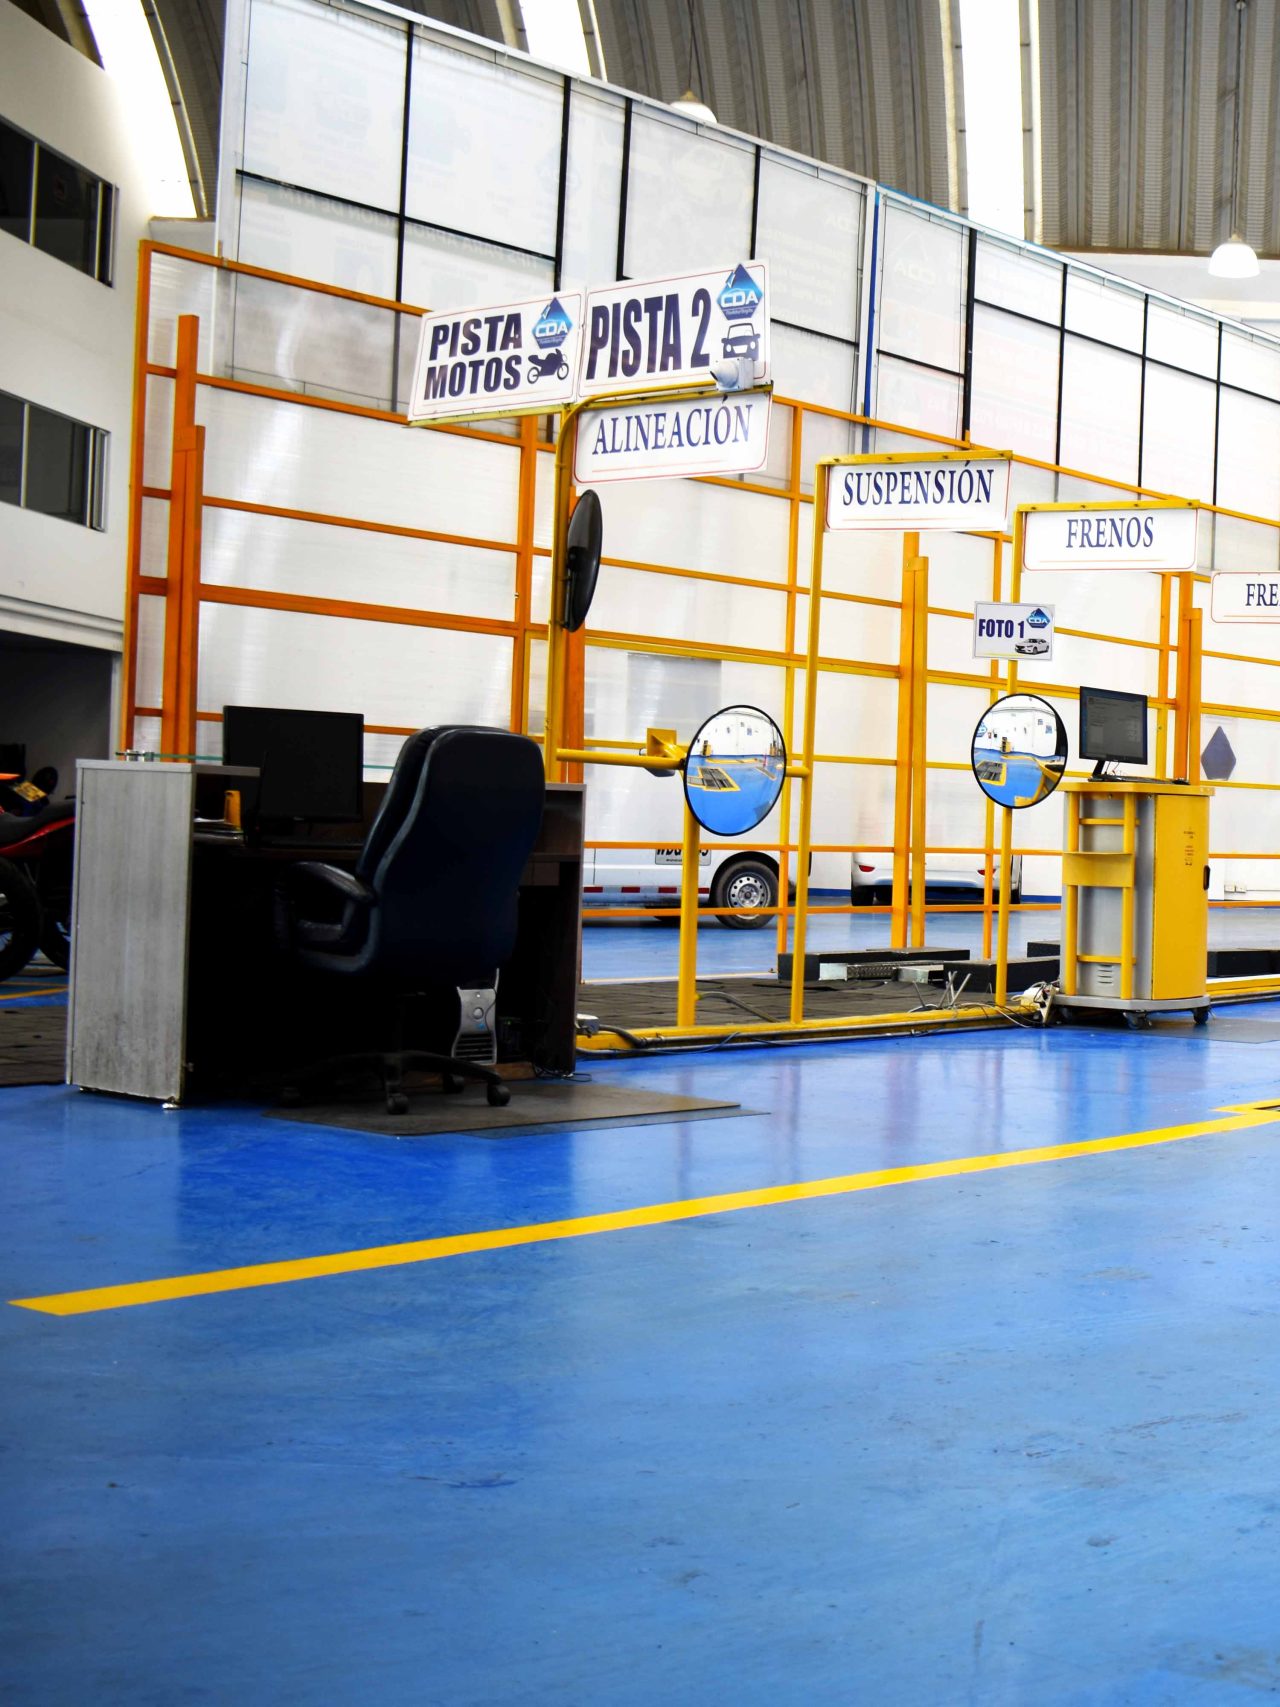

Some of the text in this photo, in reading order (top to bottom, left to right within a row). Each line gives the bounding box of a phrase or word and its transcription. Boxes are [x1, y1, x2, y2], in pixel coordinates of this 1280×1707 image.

[719, 289, 759, 308] CDA
[429, 313, 523, 361] PISTA
[535, 319, 568, 338] CDA
[586, 287, 711, 381] PISTA 2
[423, 355, 522, 401] MOTOS
[592, 395, 753, 456] ALINEACIÓN
[842, 460, 995, 506] SUSPENSIÓN
[1066, 516, 1154, 549] FRENOS
[978, 618, 1025, 639] FOTO 1
